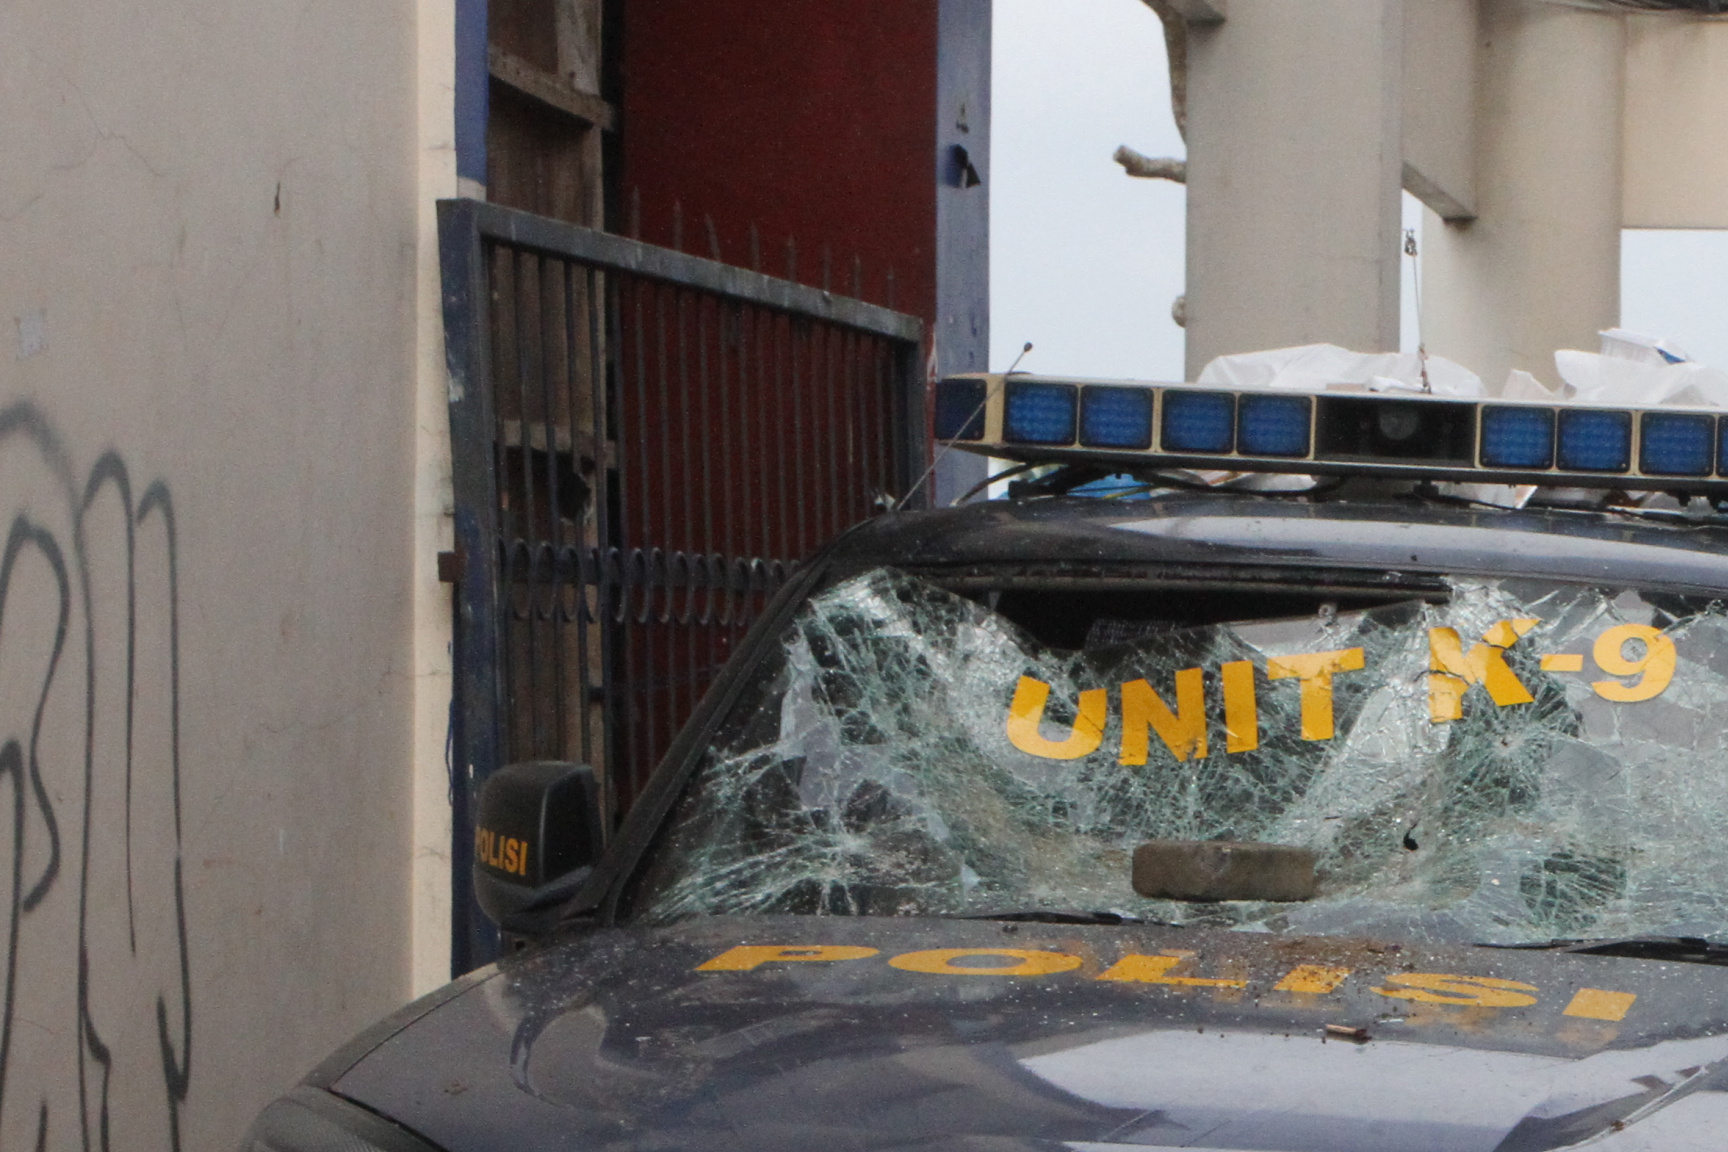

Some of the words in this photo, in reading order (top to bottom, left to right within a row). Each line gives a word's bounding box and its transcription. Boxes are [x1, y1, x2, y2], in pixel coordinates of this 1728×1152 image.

[1006, 647, 1364, 766] UNIT
[1427, 617, 1678, 723] K-9
[694, 945, 1637, 1023] POLISI
